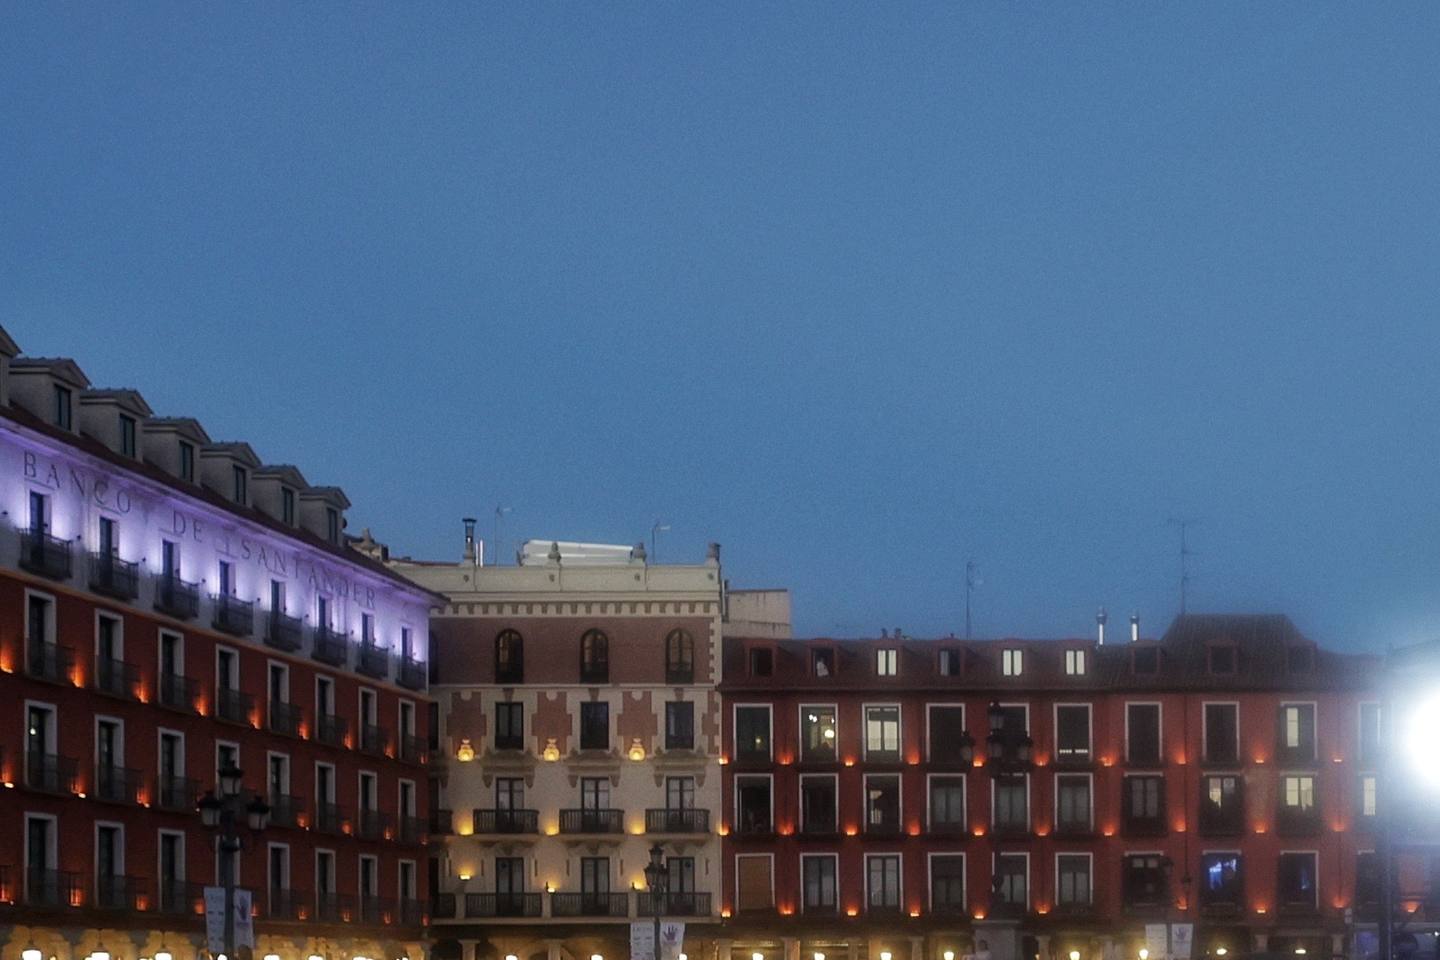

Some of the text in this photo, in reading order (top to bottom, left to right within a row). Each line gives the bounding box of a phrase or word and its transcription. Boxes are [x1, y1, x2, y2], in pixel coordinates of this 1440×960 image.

[23, 450, 376, 609] BANCO DE SANTANDER
